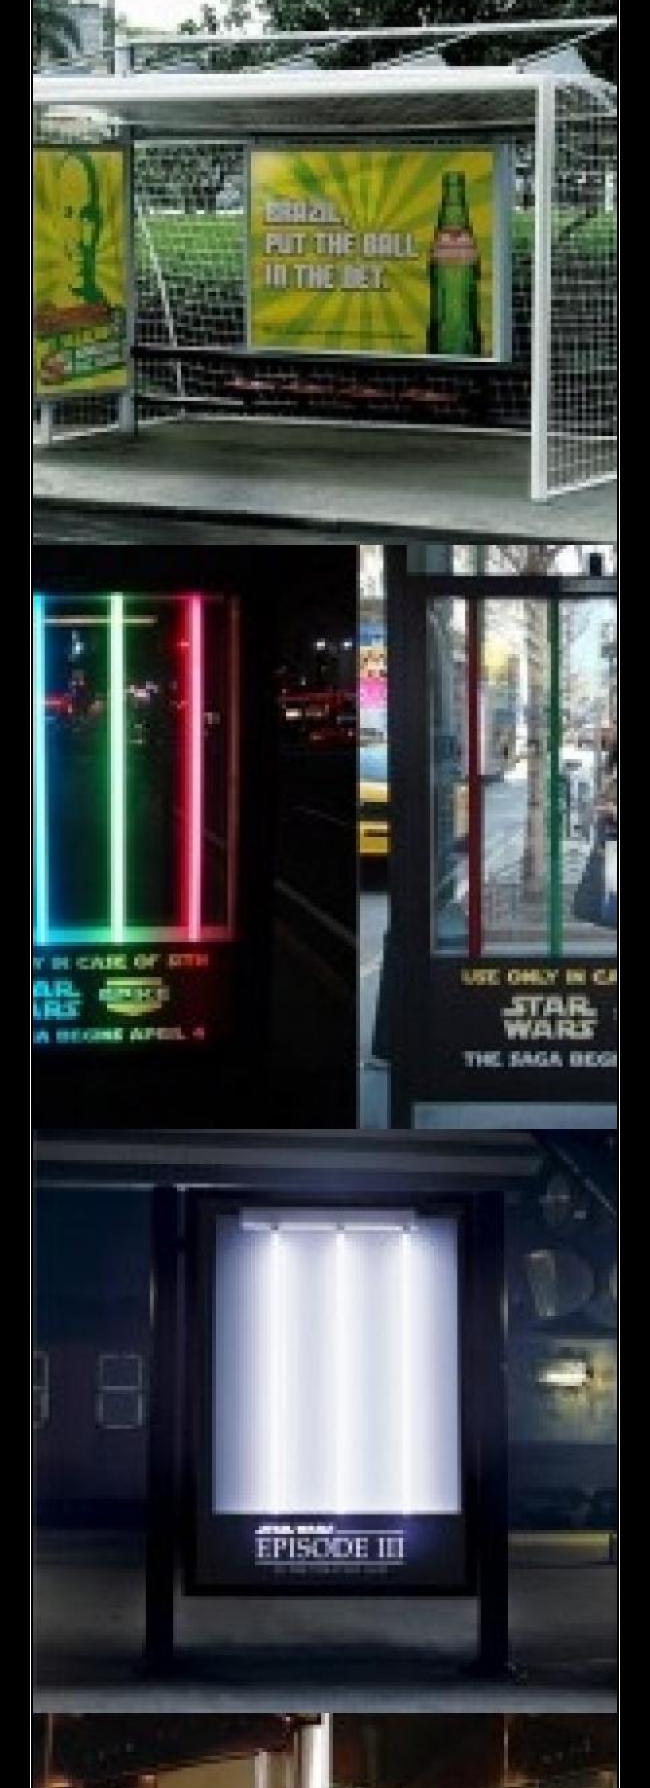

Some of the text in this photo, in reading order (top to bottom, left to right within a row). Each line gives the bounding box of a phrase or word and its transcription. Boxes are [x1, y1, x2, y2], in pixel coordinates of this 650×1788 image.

[265, 231, 305, 256] PUT
[314, 231, 356, 256] THE
[363, 231, 418, 258] BALL
[265, 263, 288, 290] IN
[293, 263, 334, 291] THE
[76, 955, 127, 971] CASE
[133, 954, 161, 970] OF
[461, 968, 500, 986] USE
[507, 968, 559, 986] ONLY
[566, 968, 587, 986] IN
[503, 994, 599, 1017] STAR
[129, 1026, 186, 1041] APRIL
[503, 1019, 599, 1040] WARS
[464, 1050, 503, 1068] THE
[508, 1050, 563, 1068] SAGA
[255, 1537, 405, 1558] EPISODE III
